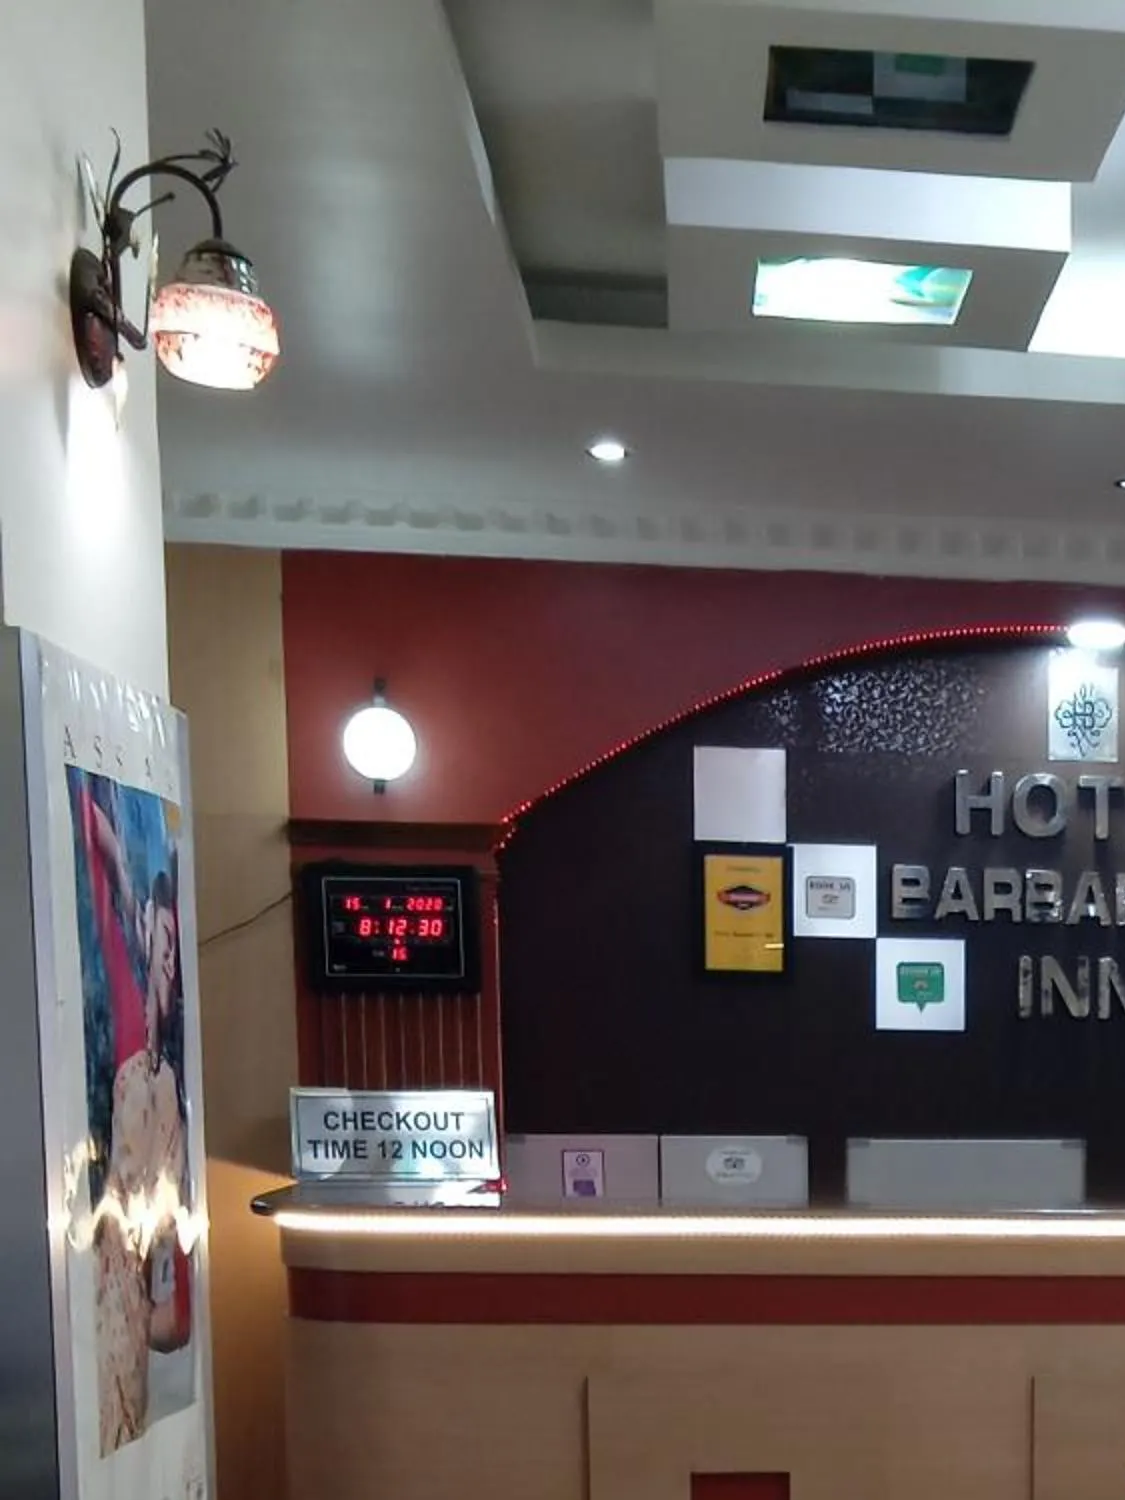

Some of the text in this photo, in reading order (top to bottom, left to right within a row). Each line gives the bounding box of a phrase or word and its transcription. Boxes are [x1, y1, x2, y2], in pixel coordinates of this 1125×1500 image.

[323, 1110, 465, 1132] CHECKOUT
[307, 1138, 485, 1160] TIME 12 NOON
